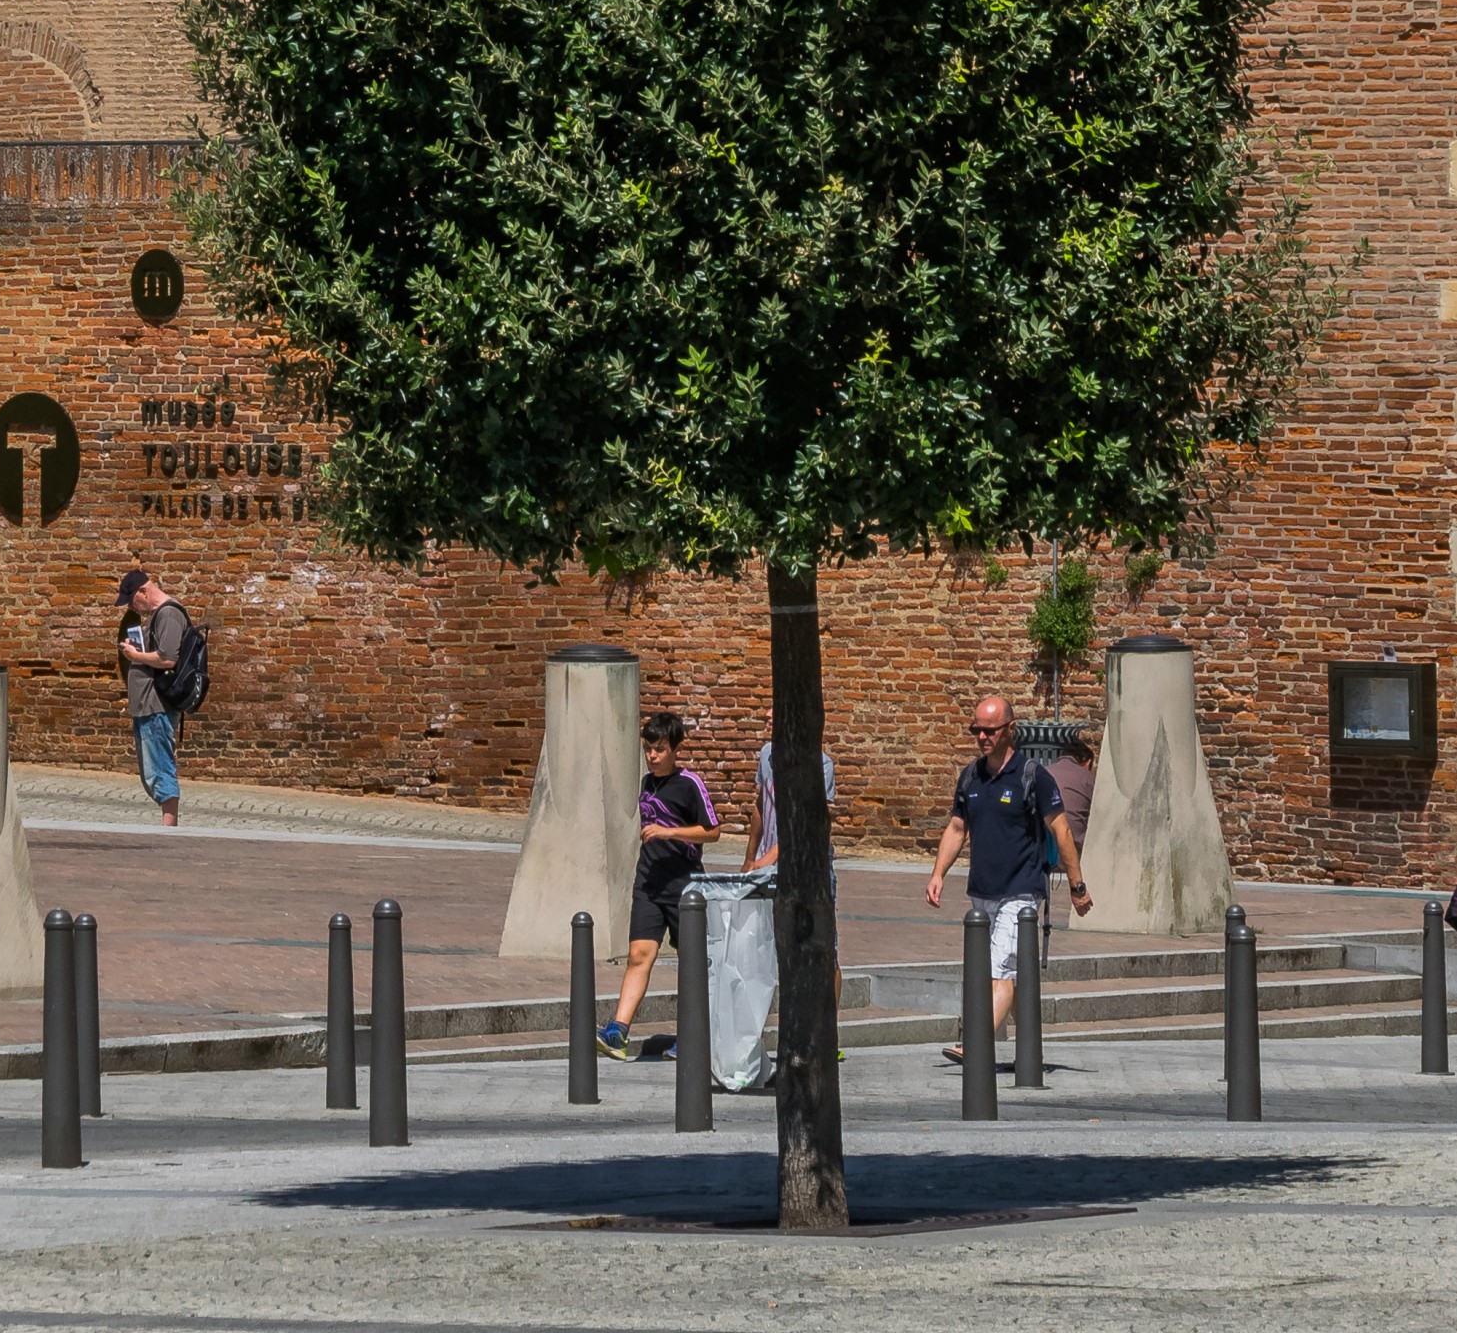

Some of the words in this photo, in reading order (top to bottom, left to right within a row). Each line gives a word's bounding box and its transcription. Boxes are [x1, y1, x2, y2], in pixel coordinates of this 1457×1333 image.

[6, 423, 57, 527] T
[142, 494, 211, 520] PALAIS
[223, 494, 248, 520] DE
